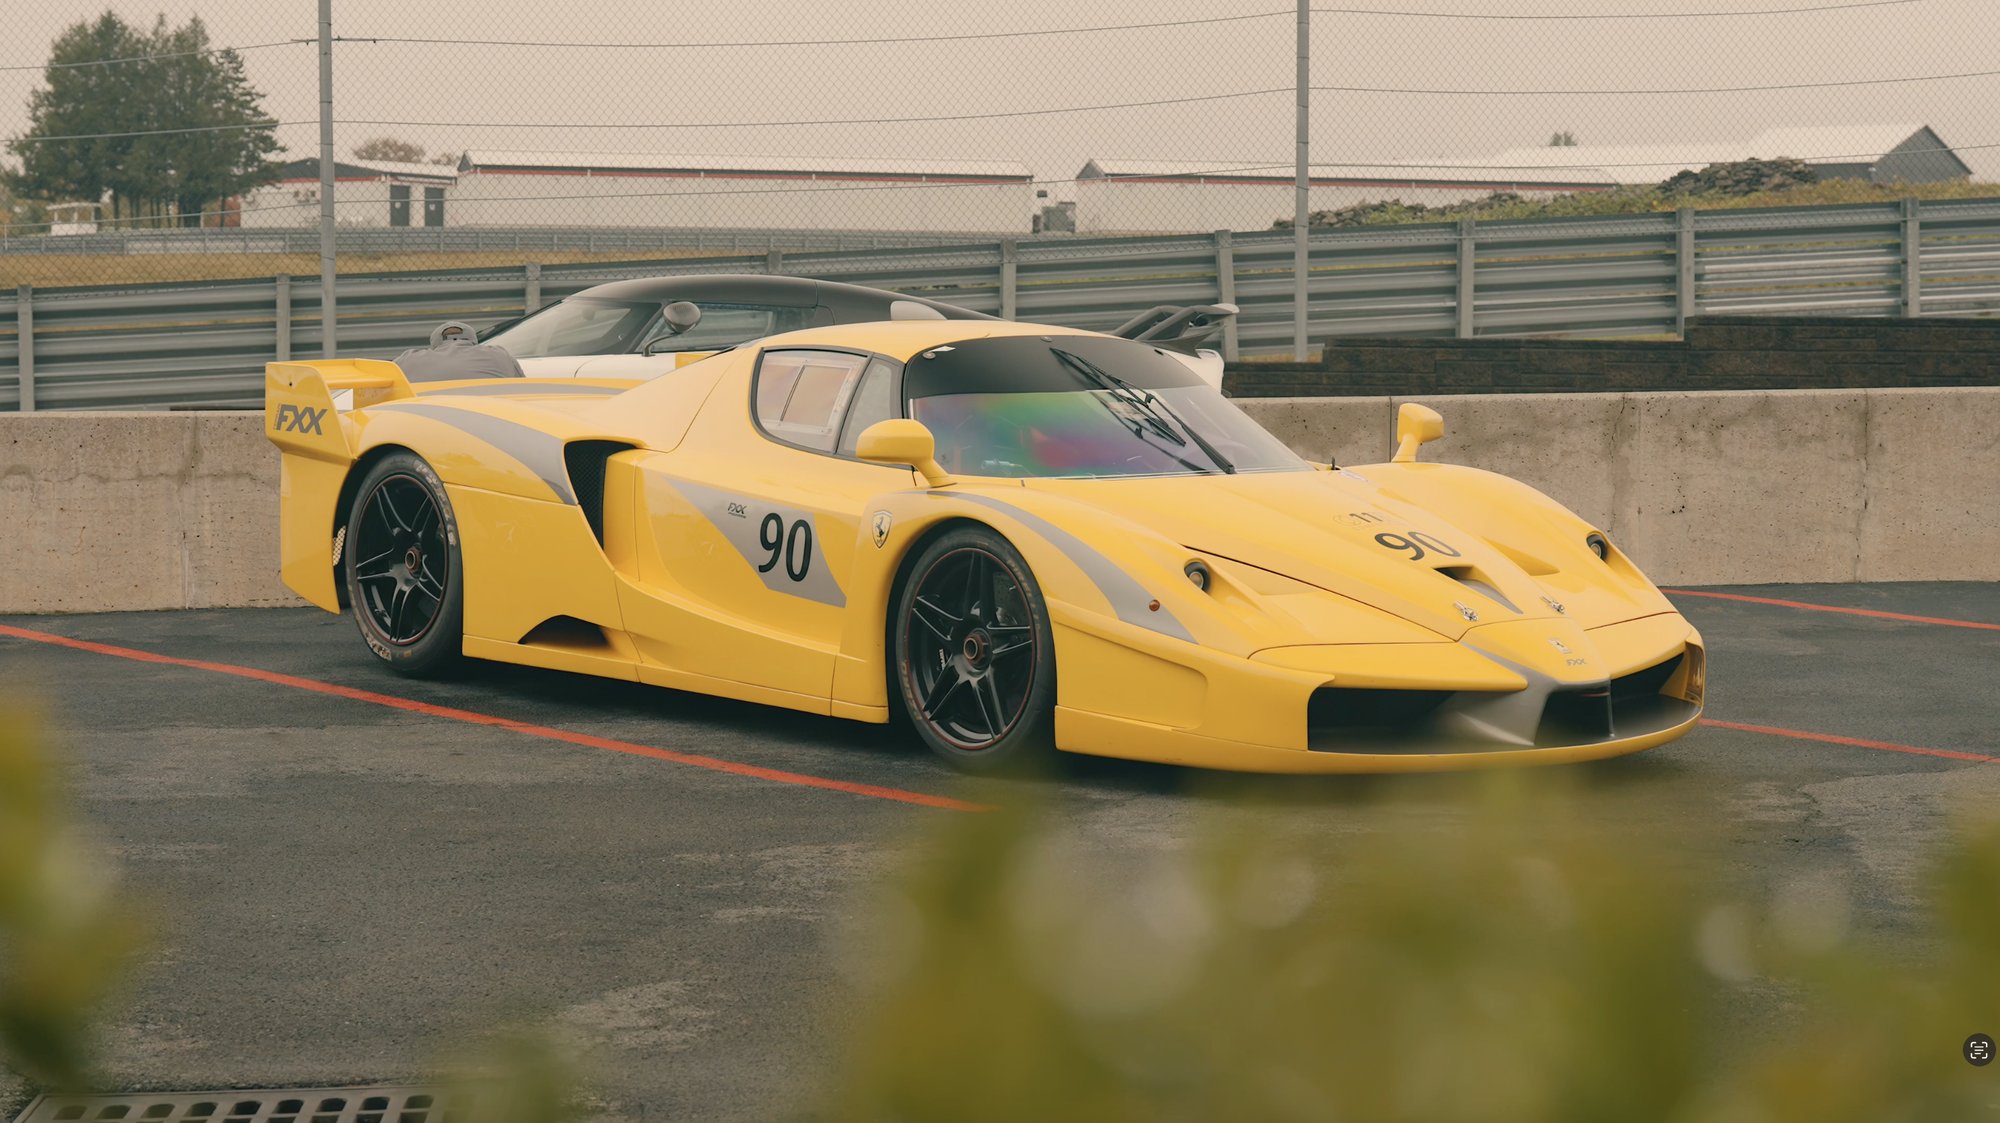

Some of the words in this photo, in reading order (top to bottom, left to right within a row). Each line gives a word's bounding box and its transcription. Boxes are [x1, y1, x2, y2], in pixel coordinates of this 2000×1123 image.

[275, 403, 329, 436] FXX
[727, 502, 748, 515] FXX
[758, 512, 813, 582] 90
[1374, 531, 1462, 561] 90
